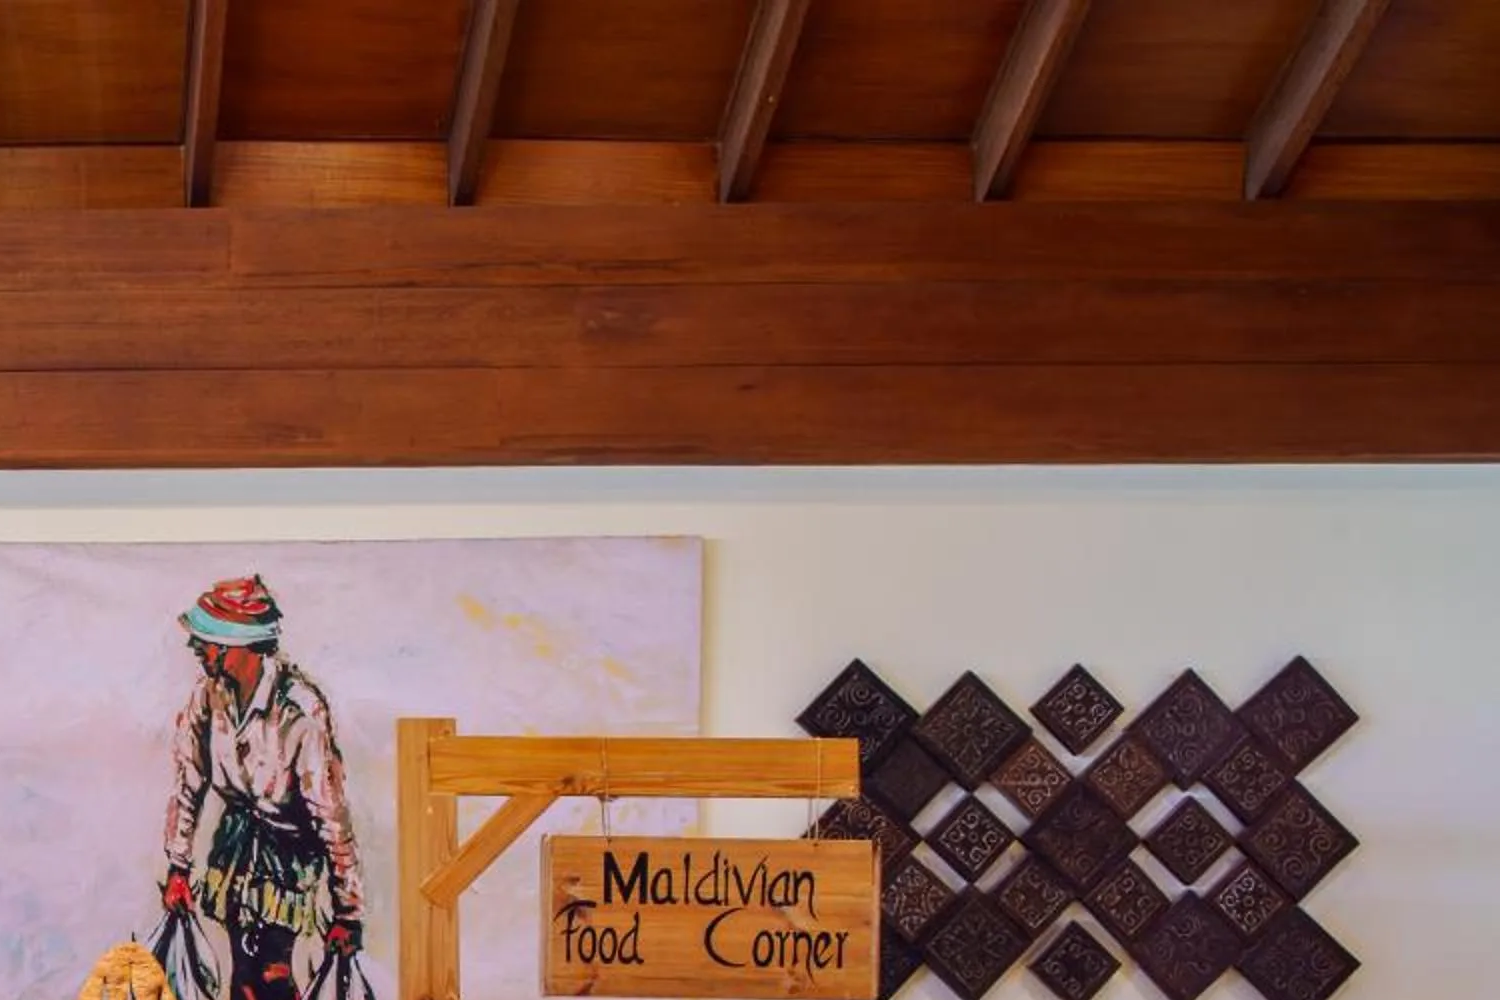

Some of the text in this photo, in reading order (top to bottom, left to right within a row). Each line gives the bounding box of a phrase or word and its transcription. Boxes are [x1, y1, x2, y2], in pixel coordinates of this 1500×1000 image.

[602, 849, 818, 923] Maldivian
[553, 899, 850, 986] Food Corner
